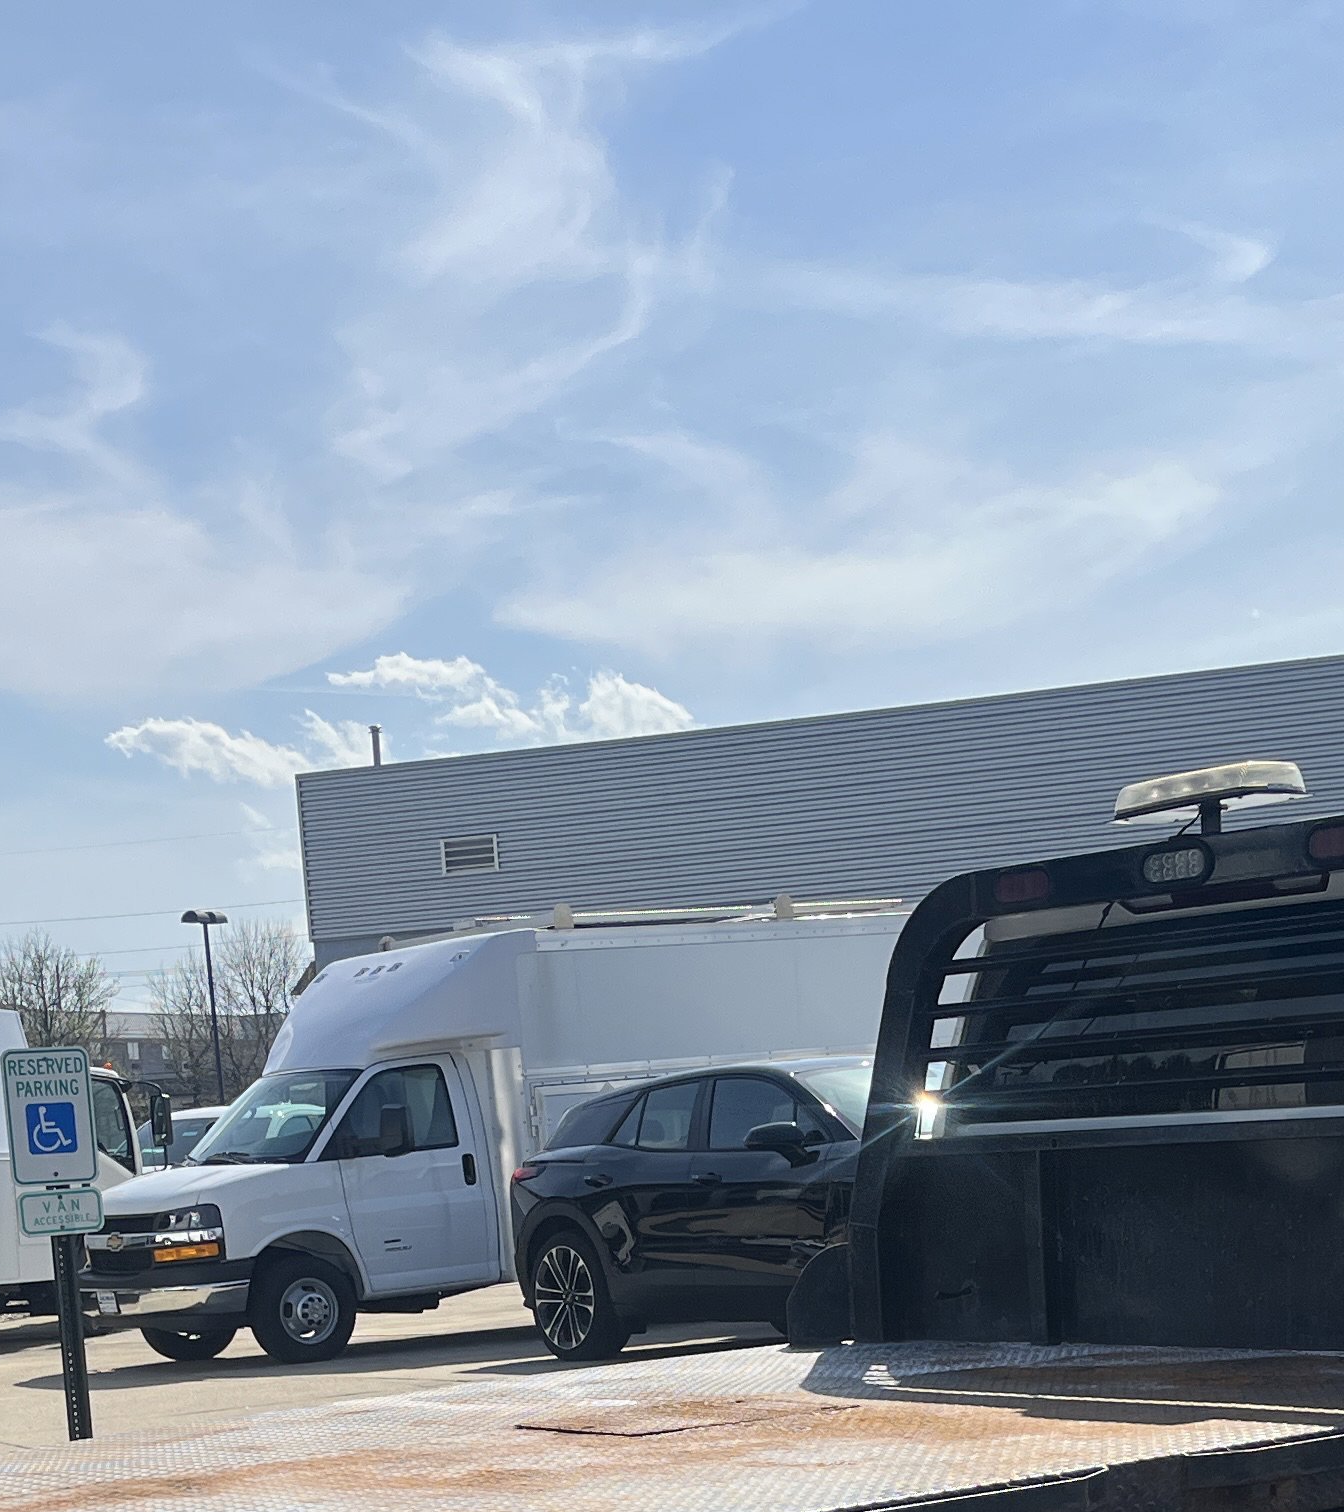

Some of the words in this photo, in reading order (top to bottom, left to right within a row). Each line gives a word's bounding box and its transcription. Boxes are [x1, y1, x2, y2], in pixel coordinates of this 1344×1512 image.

[7, 1056, 83, 1077] RESERVED
[15, 1078, 80, 1098] PARKING
[42, 1199, 81, 1214] VAN
[33, 1213, 91, 1226] ACCESSIBLE
